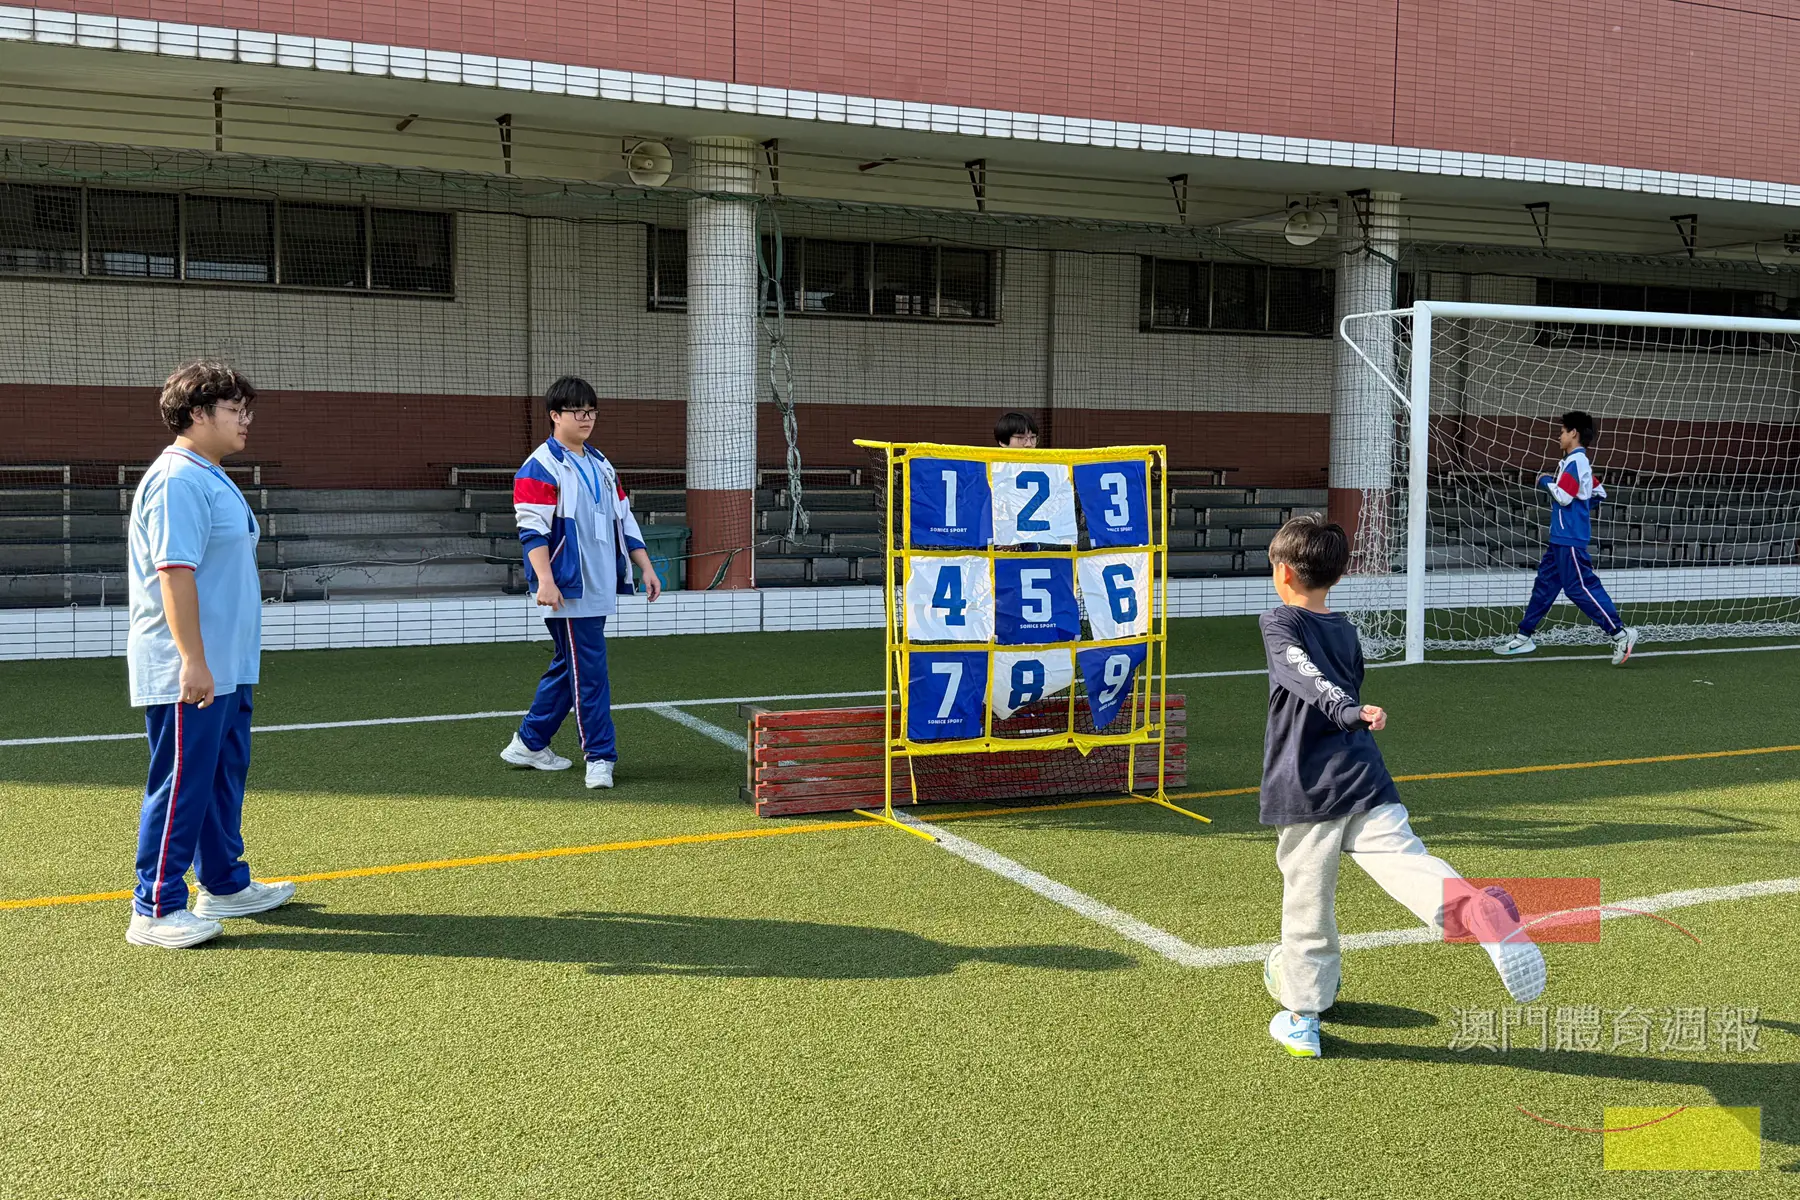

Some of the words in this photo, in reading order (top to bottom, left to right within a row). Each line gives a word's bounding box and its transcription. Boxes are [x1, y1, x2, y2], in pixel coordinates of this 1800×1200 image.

[942, 470, 957, 526] 1
[1016, 470, 1051, 532] 2
[1099, 472, 1130, 527] 3
[932, 565, 967, 626] 4
[1020, 568, 1052, 623] 5
[1102, 563, 1138, 625] 6
[931, 662, 963, 718] 7
[1008, 659, 1045, 711] 8
[1098, 653, 1132, 705] 9
